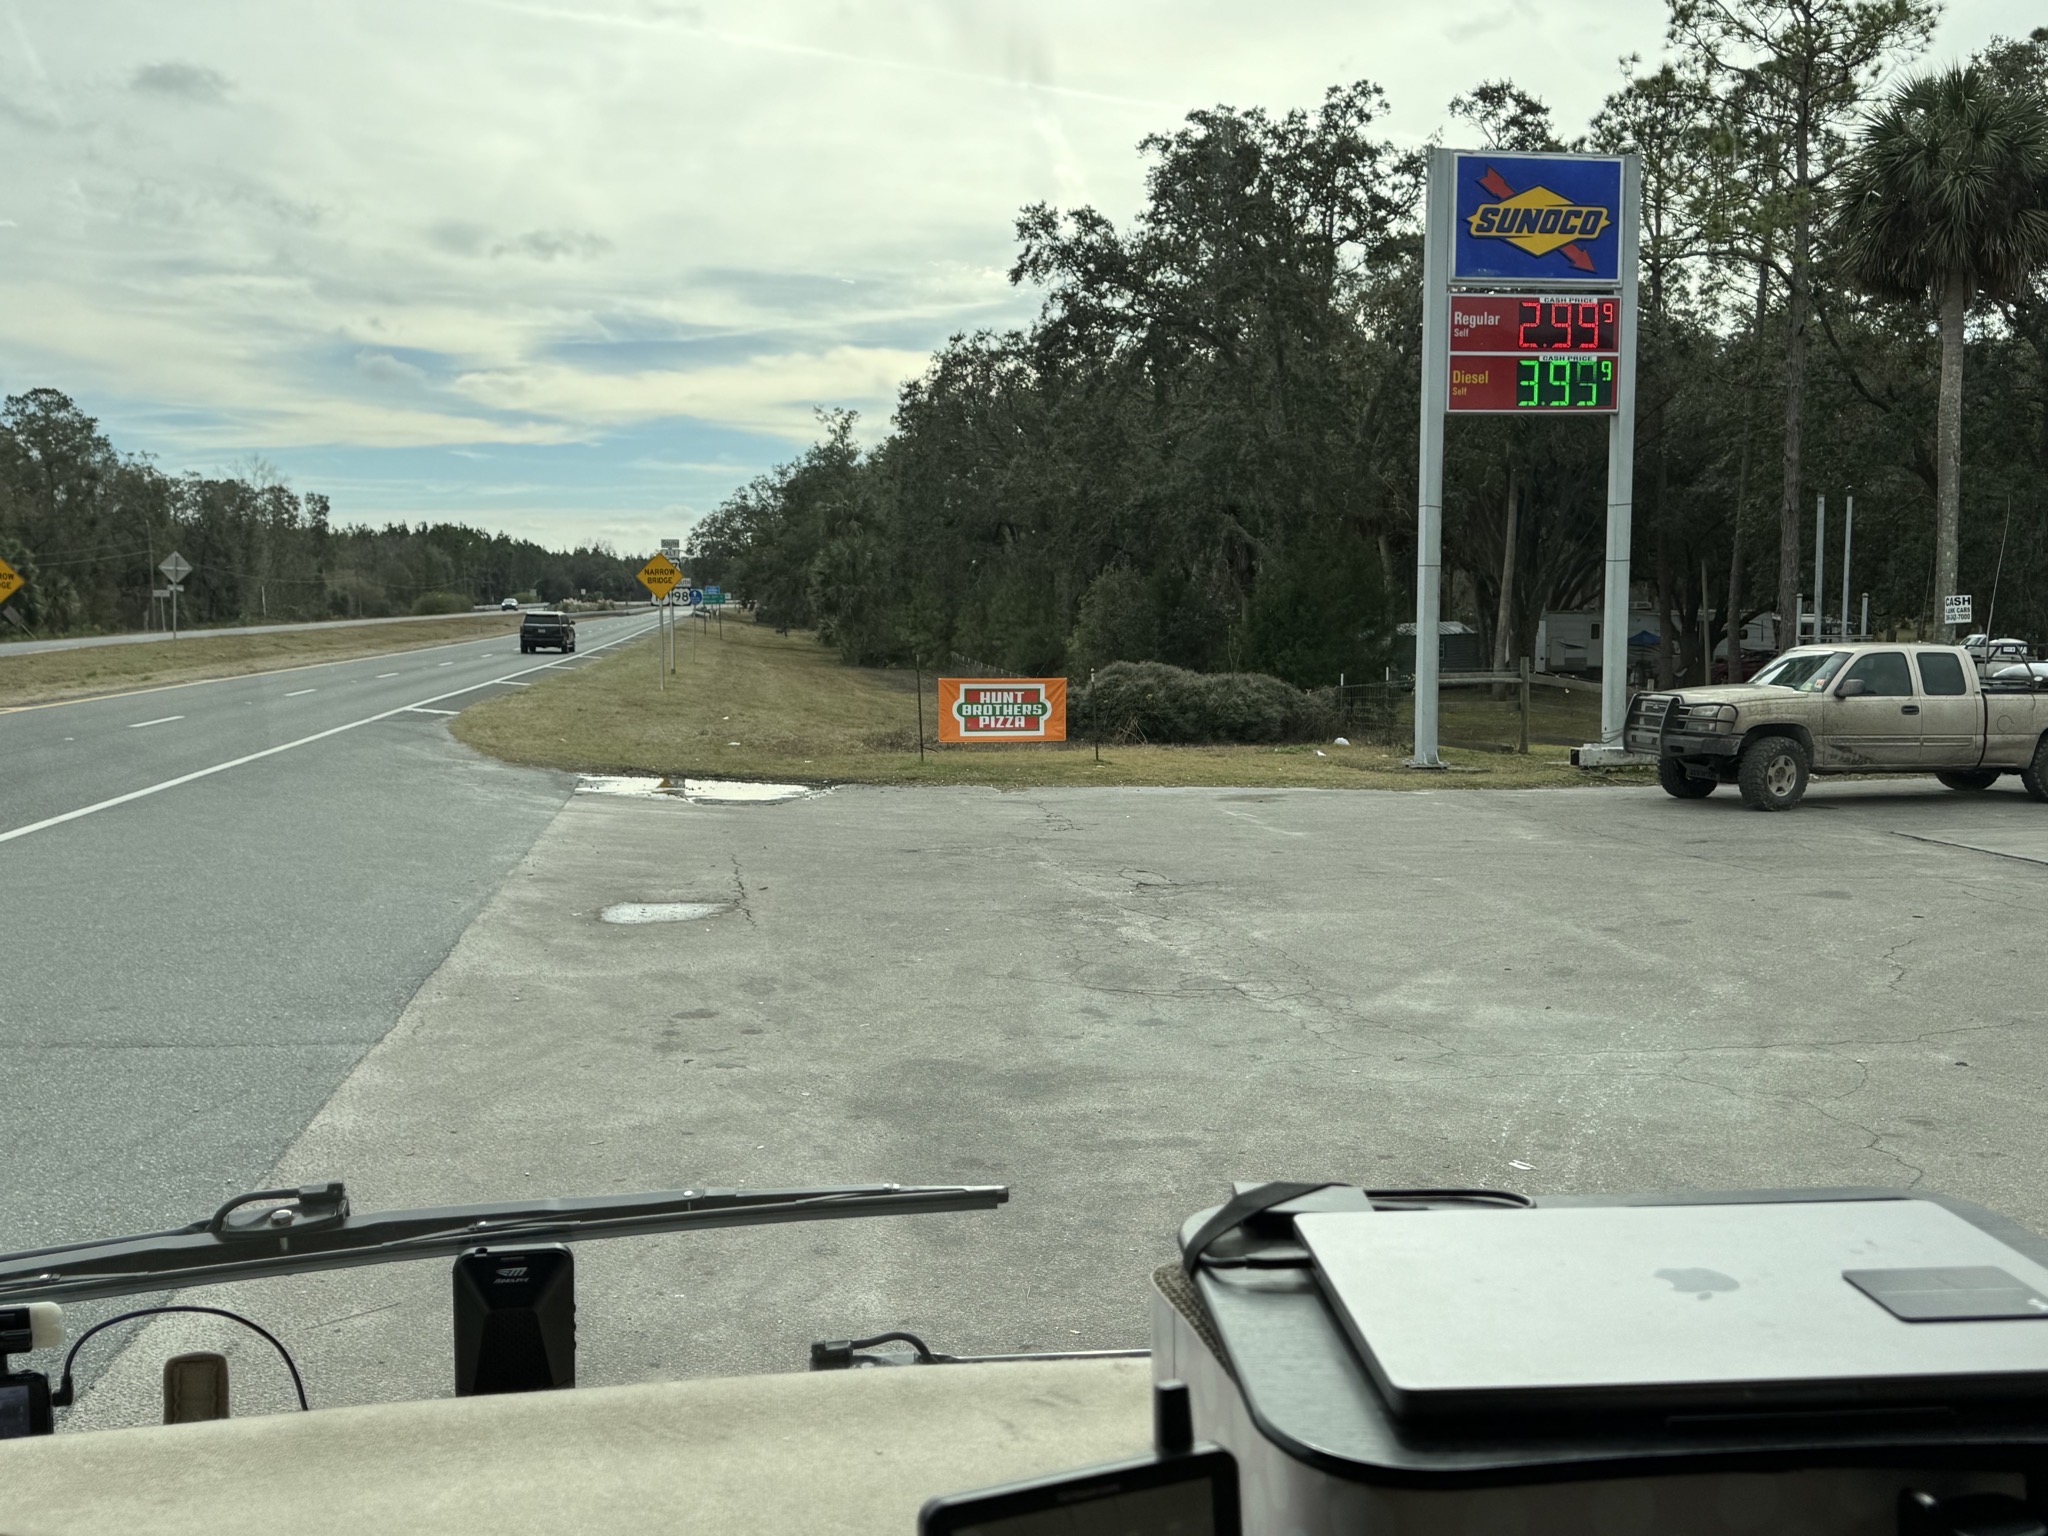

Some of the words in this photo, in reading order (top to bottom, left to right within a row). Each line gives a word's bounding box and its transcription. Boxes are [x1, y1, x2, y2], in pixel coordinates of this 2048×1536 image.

[1475, 207, 1604, 235] SUNOCO
[1453, 311, 1501, 328] Regular
[1453, 328, 1469, 337] Self
[1452, 370, 1489, 384] Diesel
[1452, 386, 1467, 396] Self
[644, 568, 675, 576] NARROW
[647, 576, 673, 584] BRIDGE
[674, 591, 689, 602] 98
[1946, 597, 1970, 606] CASH
[979, 691, 1025, 704] HUNT
[961, 704, 1043, 716] BROTHERS
[978, 716, 1026, 728] PIZZA
